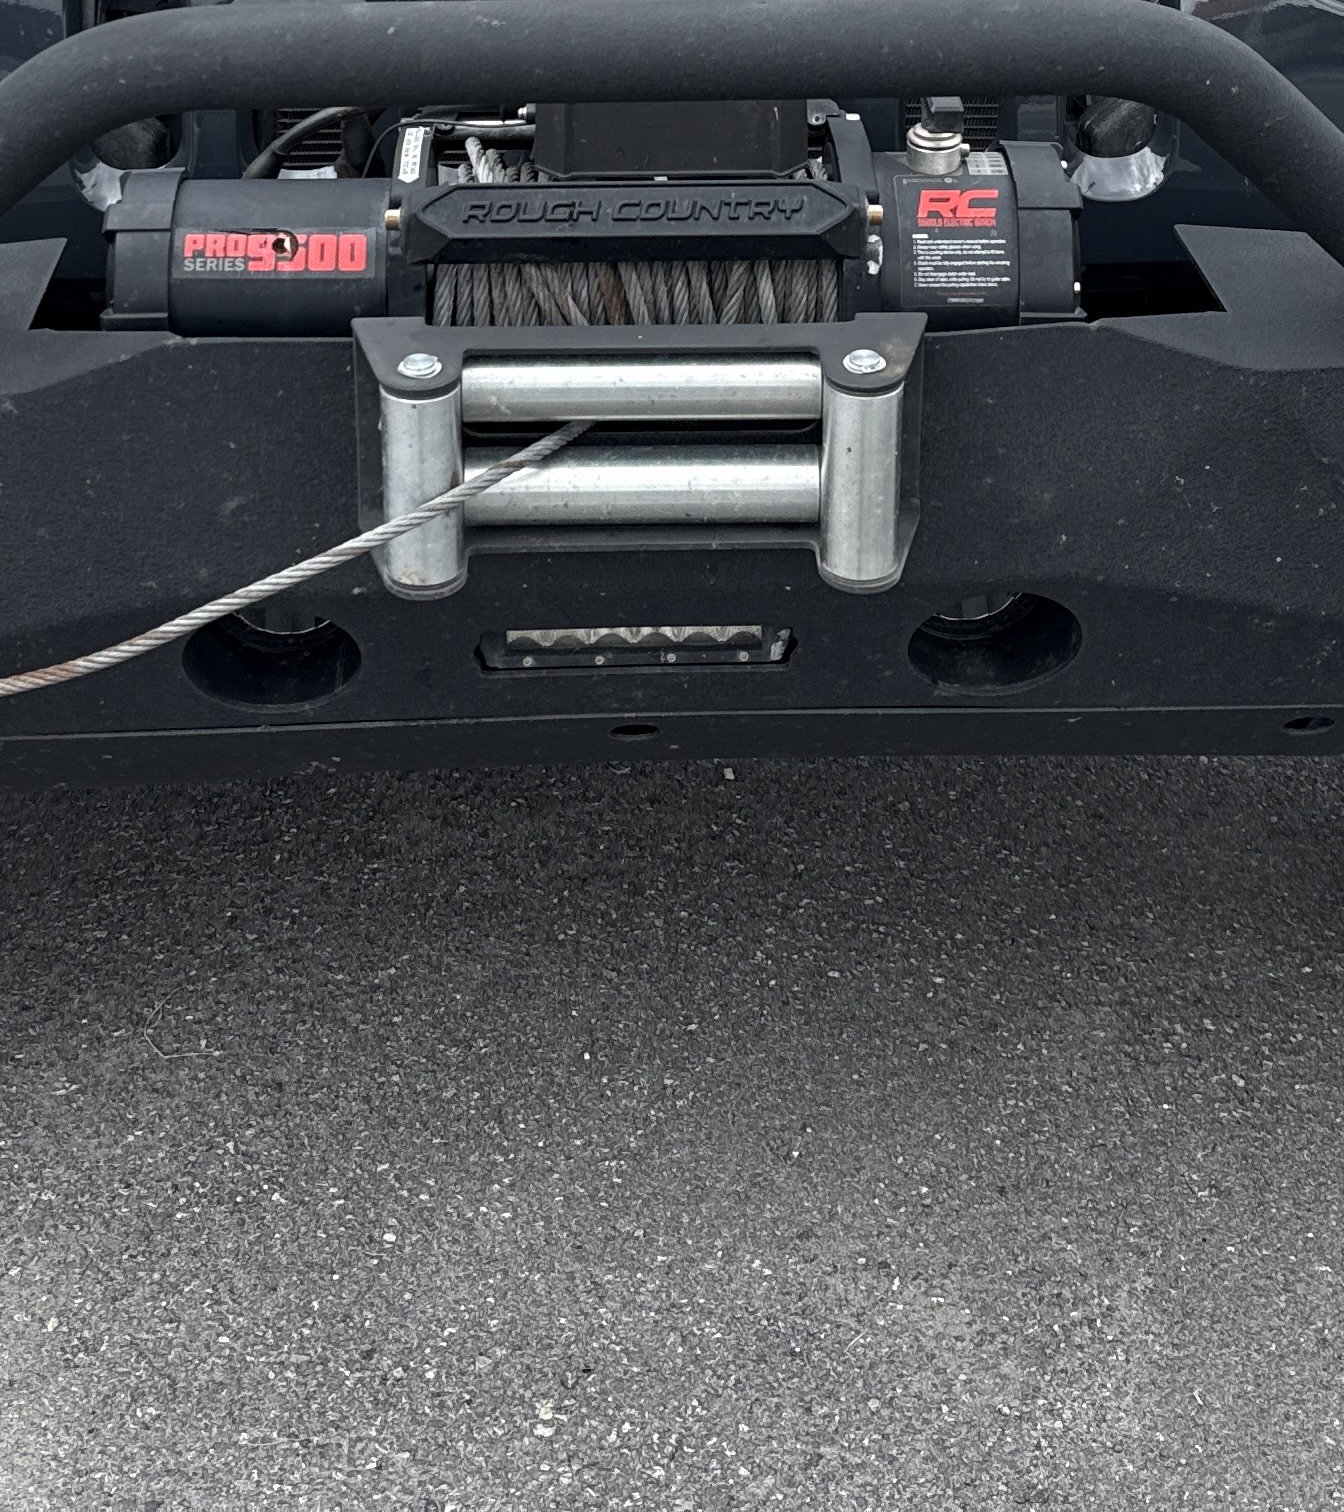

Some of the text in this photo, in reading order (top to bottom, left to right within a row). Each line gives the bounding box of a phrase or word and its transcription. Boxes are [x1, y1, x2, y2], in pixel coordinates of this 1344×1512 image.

[462, 196, 806, 224] ROUGH COUNTRY
[917, 189, 999, 218] RC
[183, 233, 248, 257] PRO
[183, 257, 246, 272] SERIES
